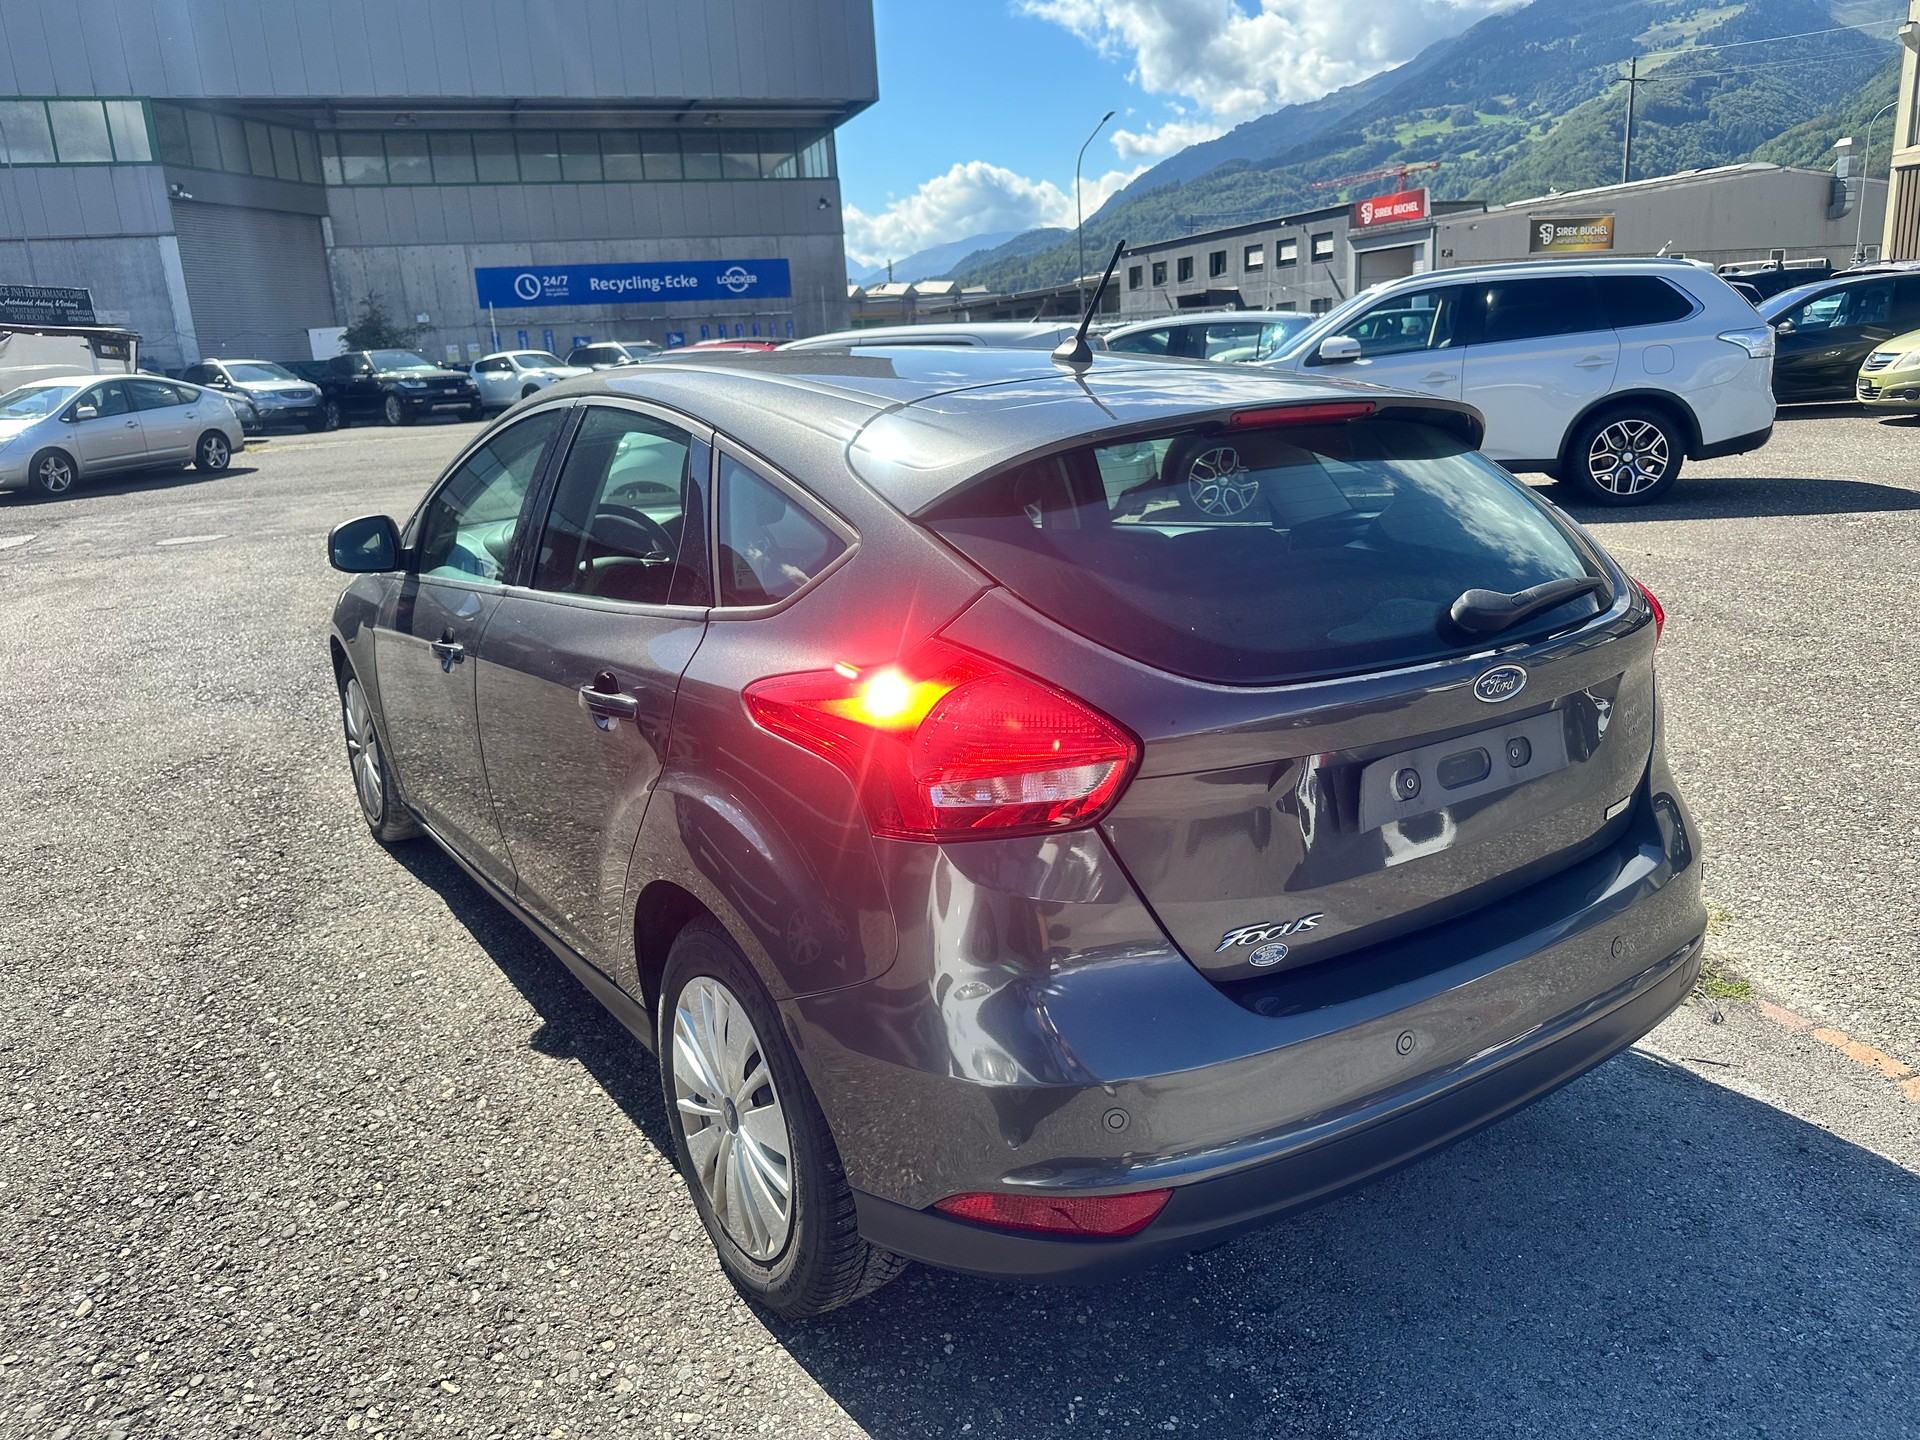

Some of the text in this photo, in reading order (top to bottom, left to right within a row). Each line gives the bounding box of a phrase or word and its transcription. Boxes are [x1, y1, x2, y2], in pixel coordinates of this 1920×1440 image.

[1556, 226, 1578, 237] SIREK
[542, 274, 569, 286] 24/7
[589, 274, 698, 294] Recycling-Ecke
[716, 274, 758, 286] LOACKER
[25, 287, 69, 299] PERFORMANCE
[1481, 672, 1516, 695] Ford
